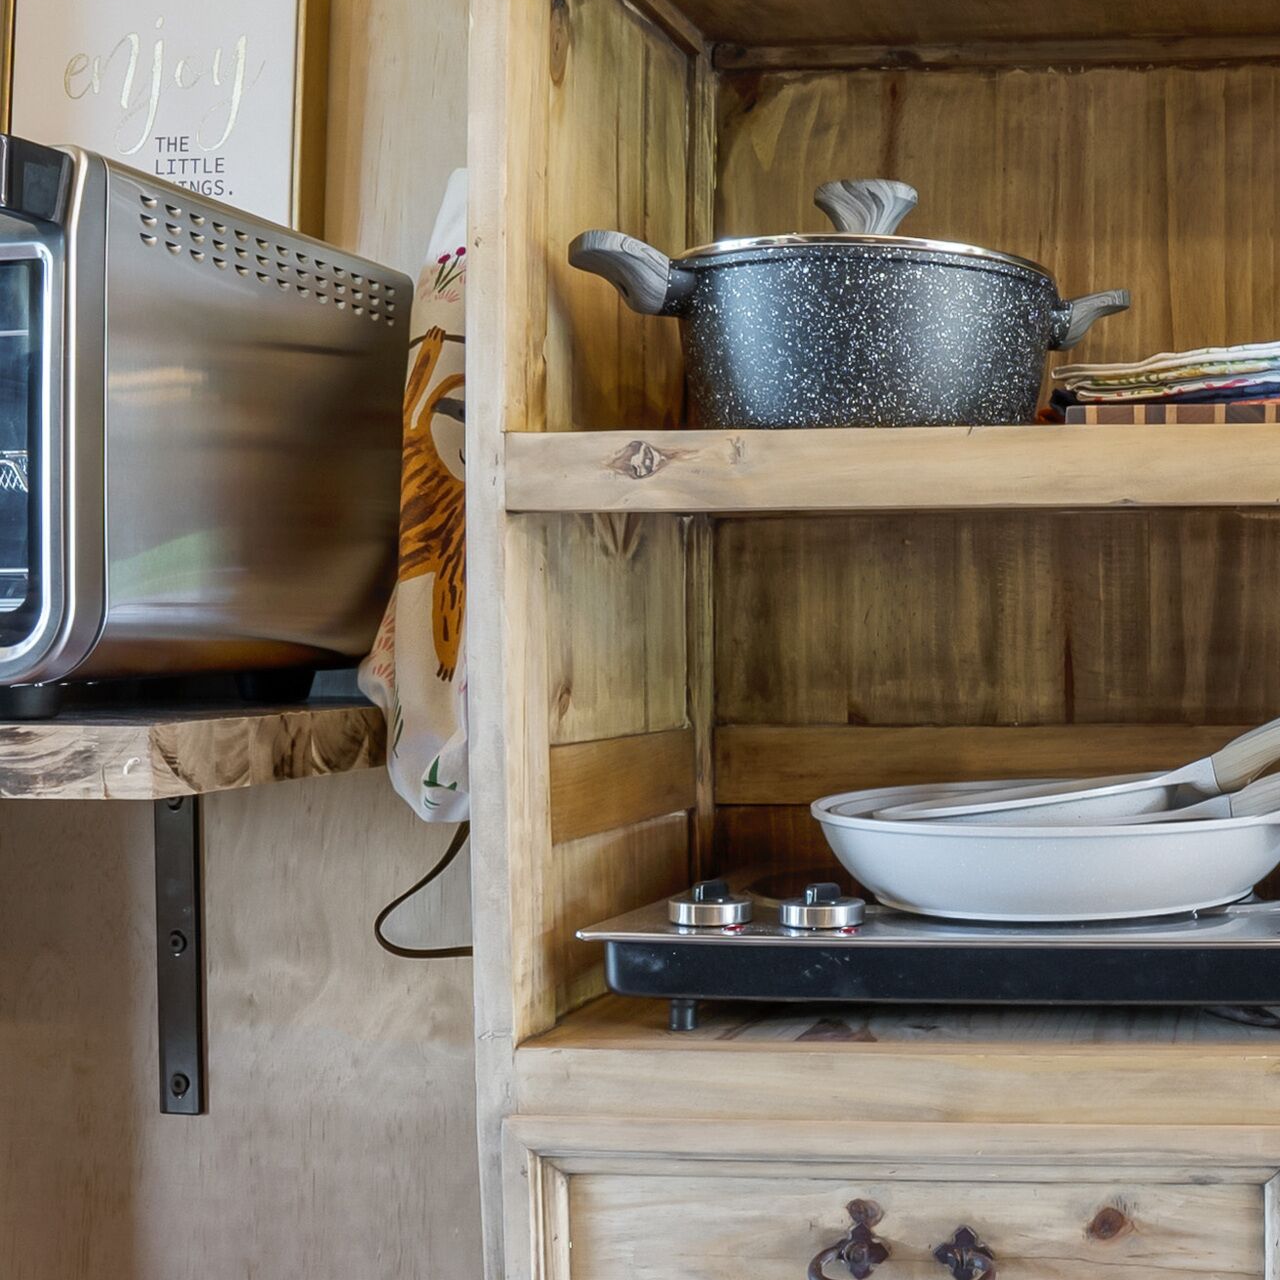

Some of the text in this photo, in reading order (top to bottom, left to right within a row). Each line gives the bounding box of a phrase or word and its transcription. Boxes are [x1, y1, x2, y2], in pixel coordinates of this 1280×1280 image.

[63, 16, 266, 155] enjoy
[154, 136, 190, 152] THE
[155, 157, 225, 175] LITTLE
